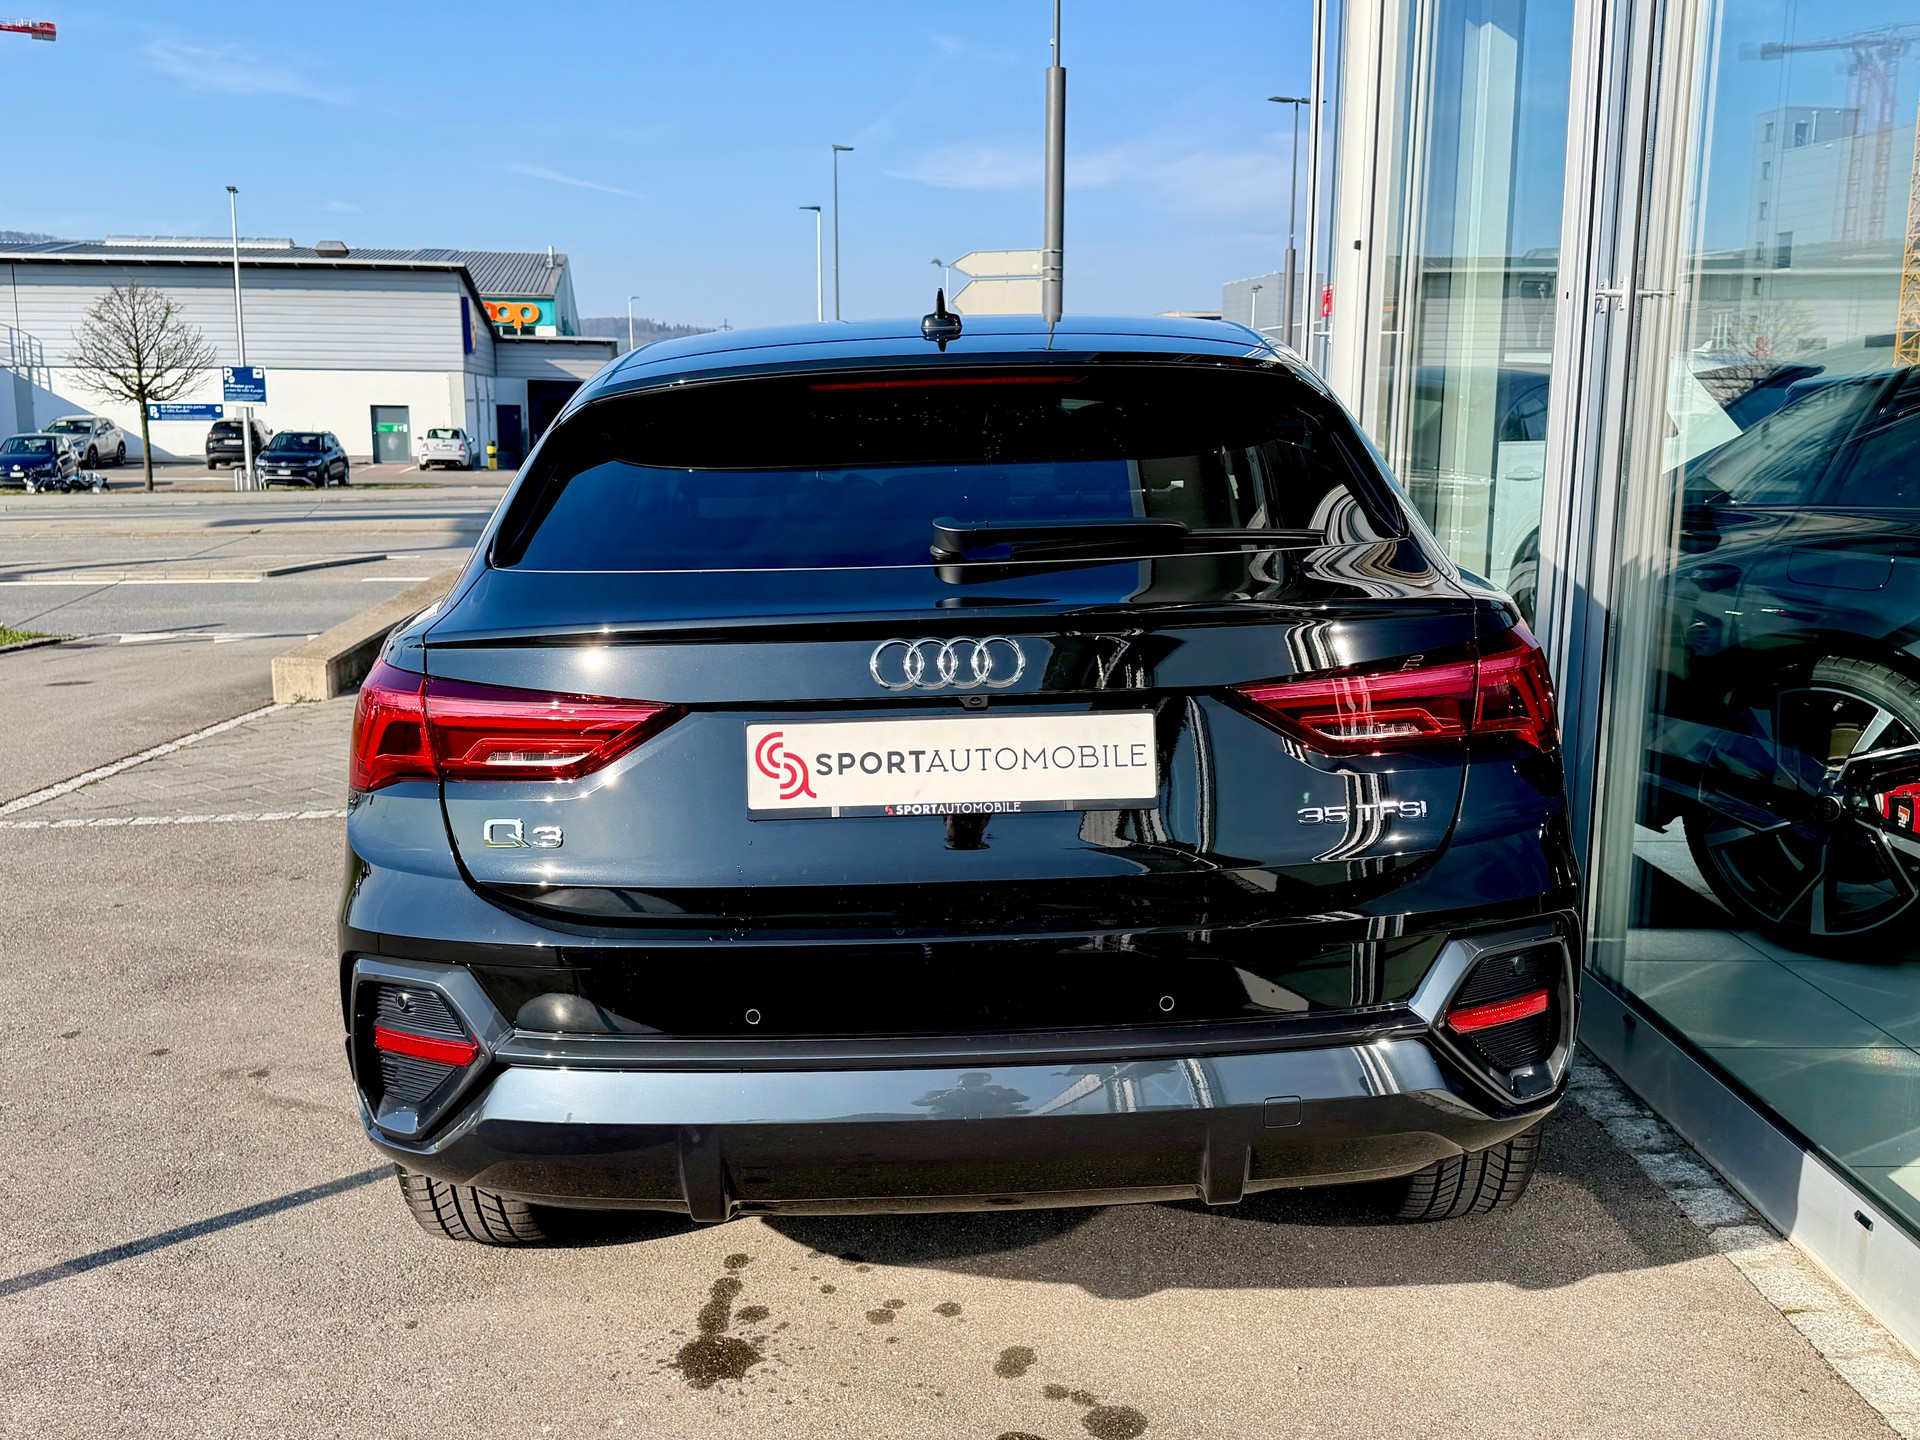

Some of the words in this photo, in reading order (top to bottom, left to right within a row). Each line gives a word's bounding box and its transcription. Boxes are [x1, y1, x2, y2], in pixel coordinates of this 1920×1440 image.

[816, 743, 1147, 776] SPORTAUTOMOBILE
[896, 801, 1022, 815] SPORTAUTOMOBILE
[1297, 806, 1348, 823] 35
[1356, 800, 1427, 821] TFSI
[483, 818, 564, 848] Q3
